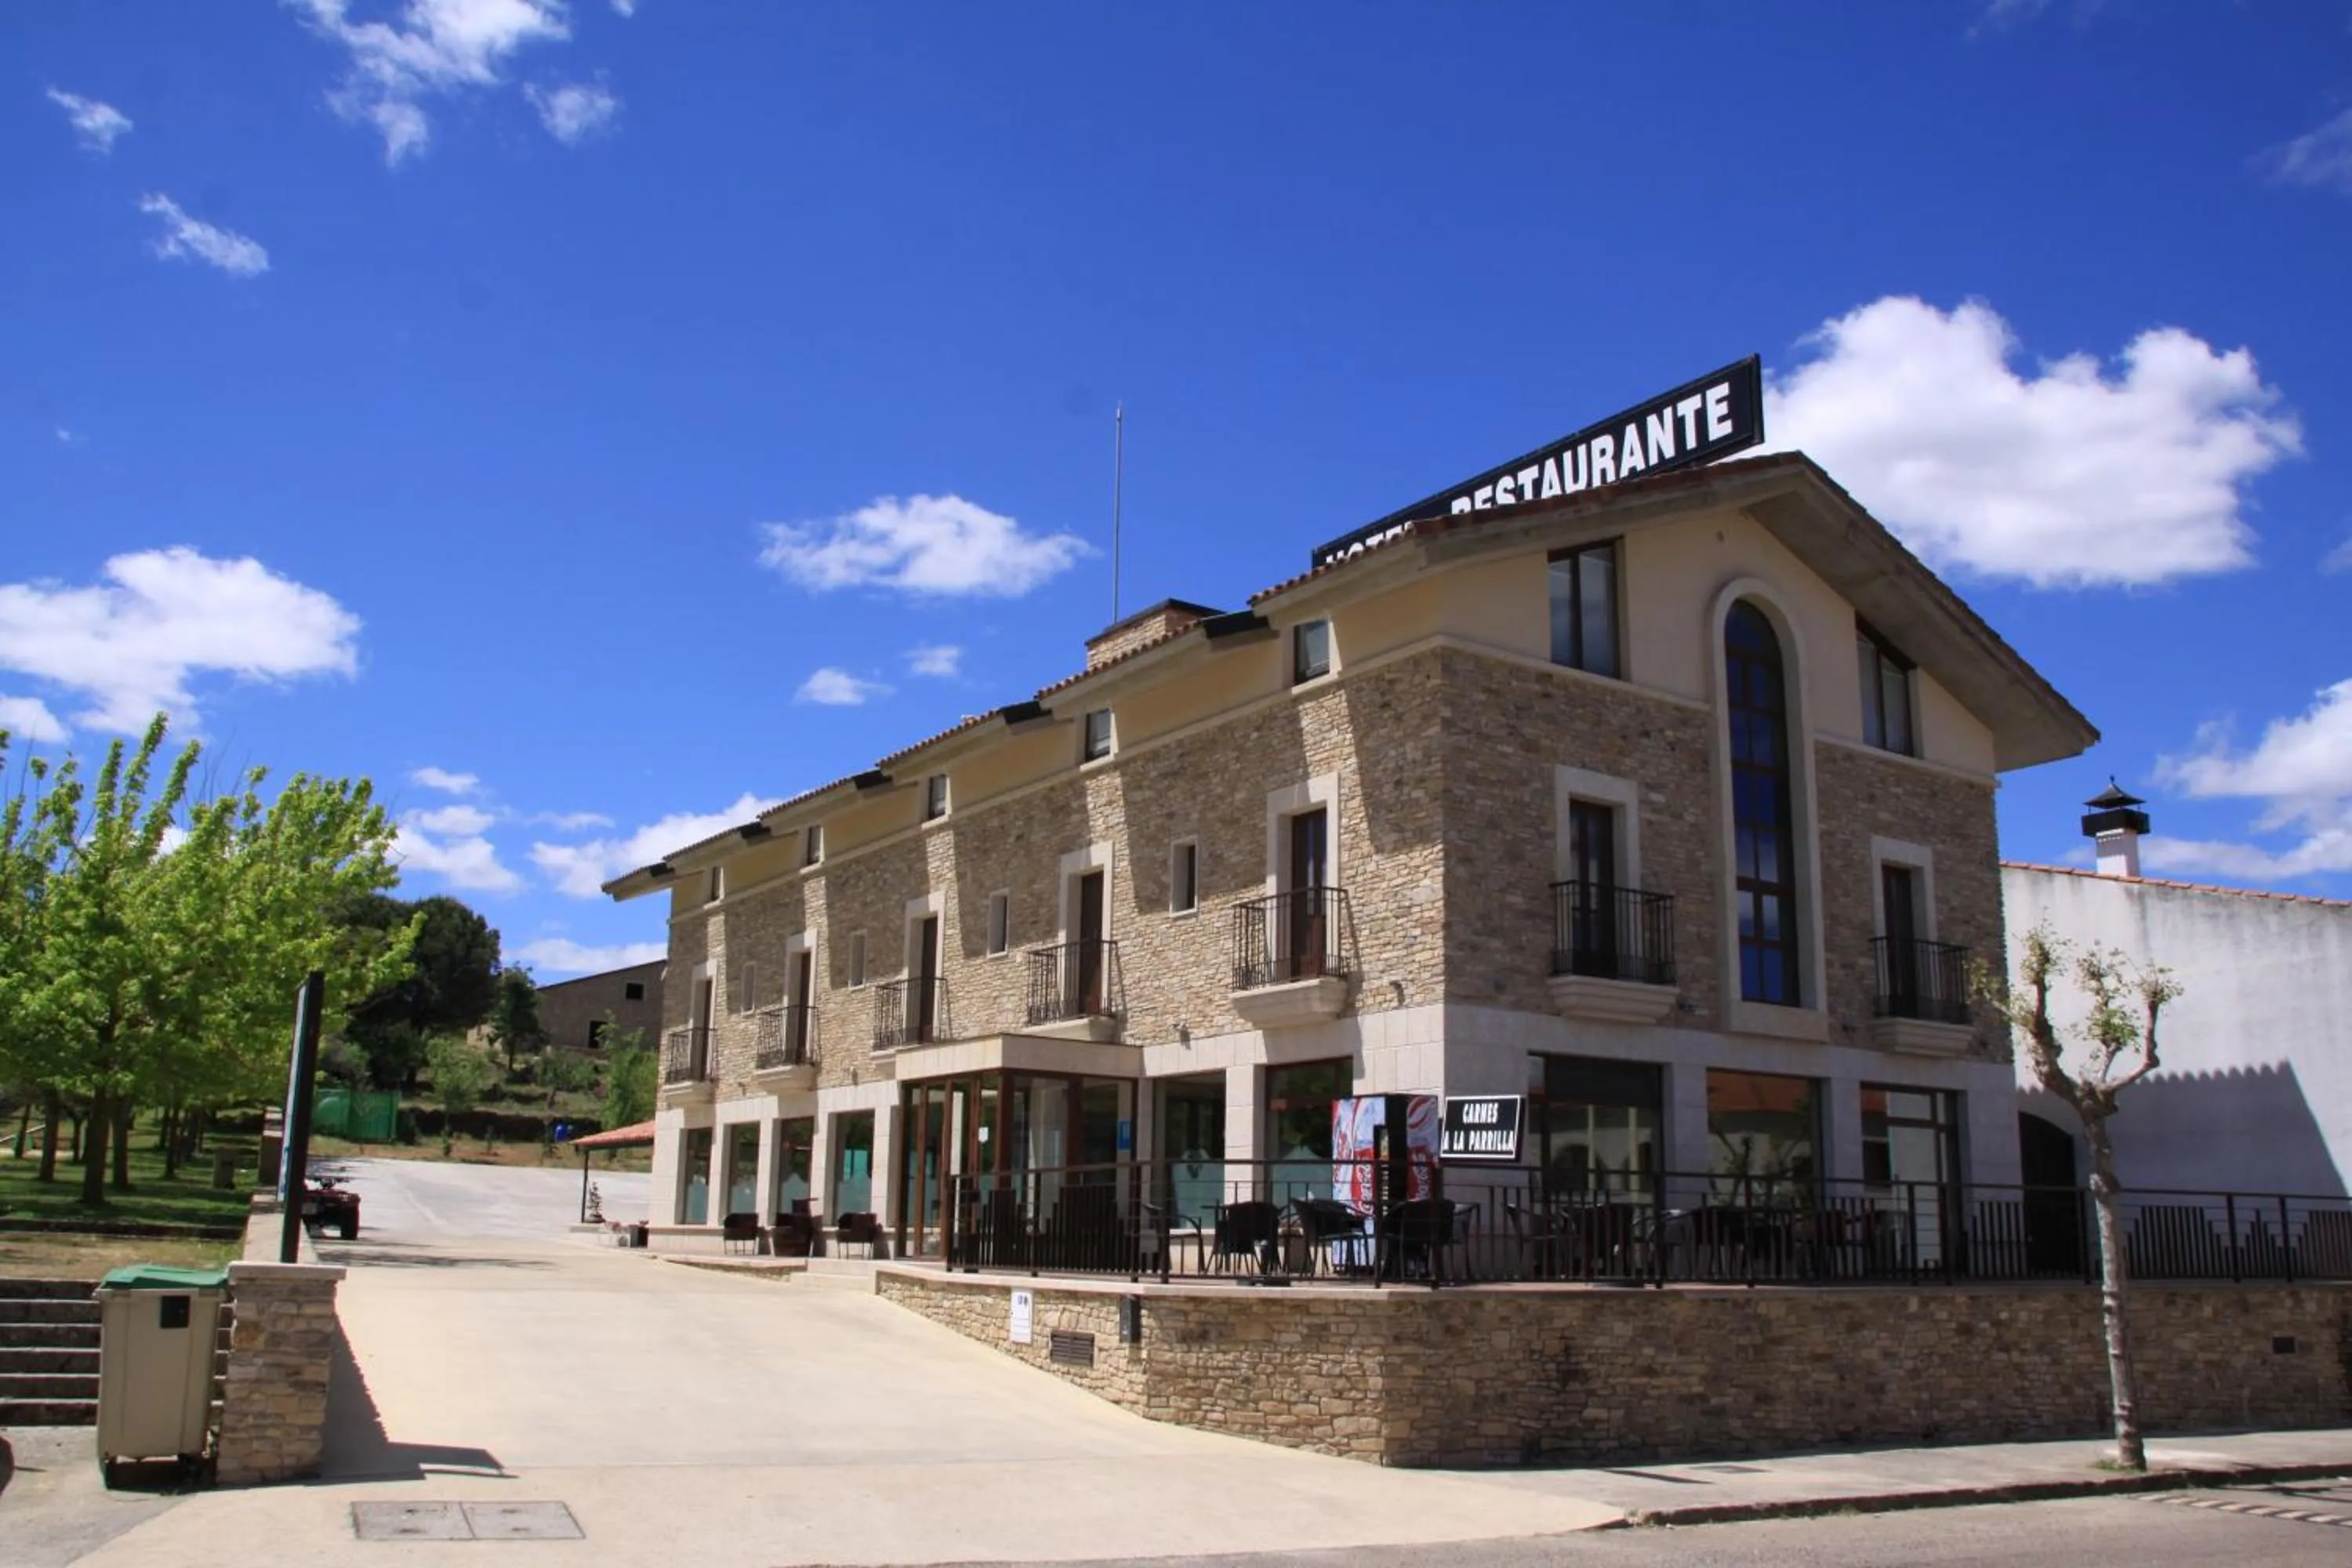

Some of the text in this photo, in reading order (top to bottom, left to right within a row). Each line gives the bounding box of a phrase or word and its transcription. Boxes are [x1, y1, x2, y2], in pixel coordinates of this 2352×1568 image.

[1462, 1102, 1498, 1124] CARNES
[1443, 1130, 1514, 1151] A LA PARRILLA
